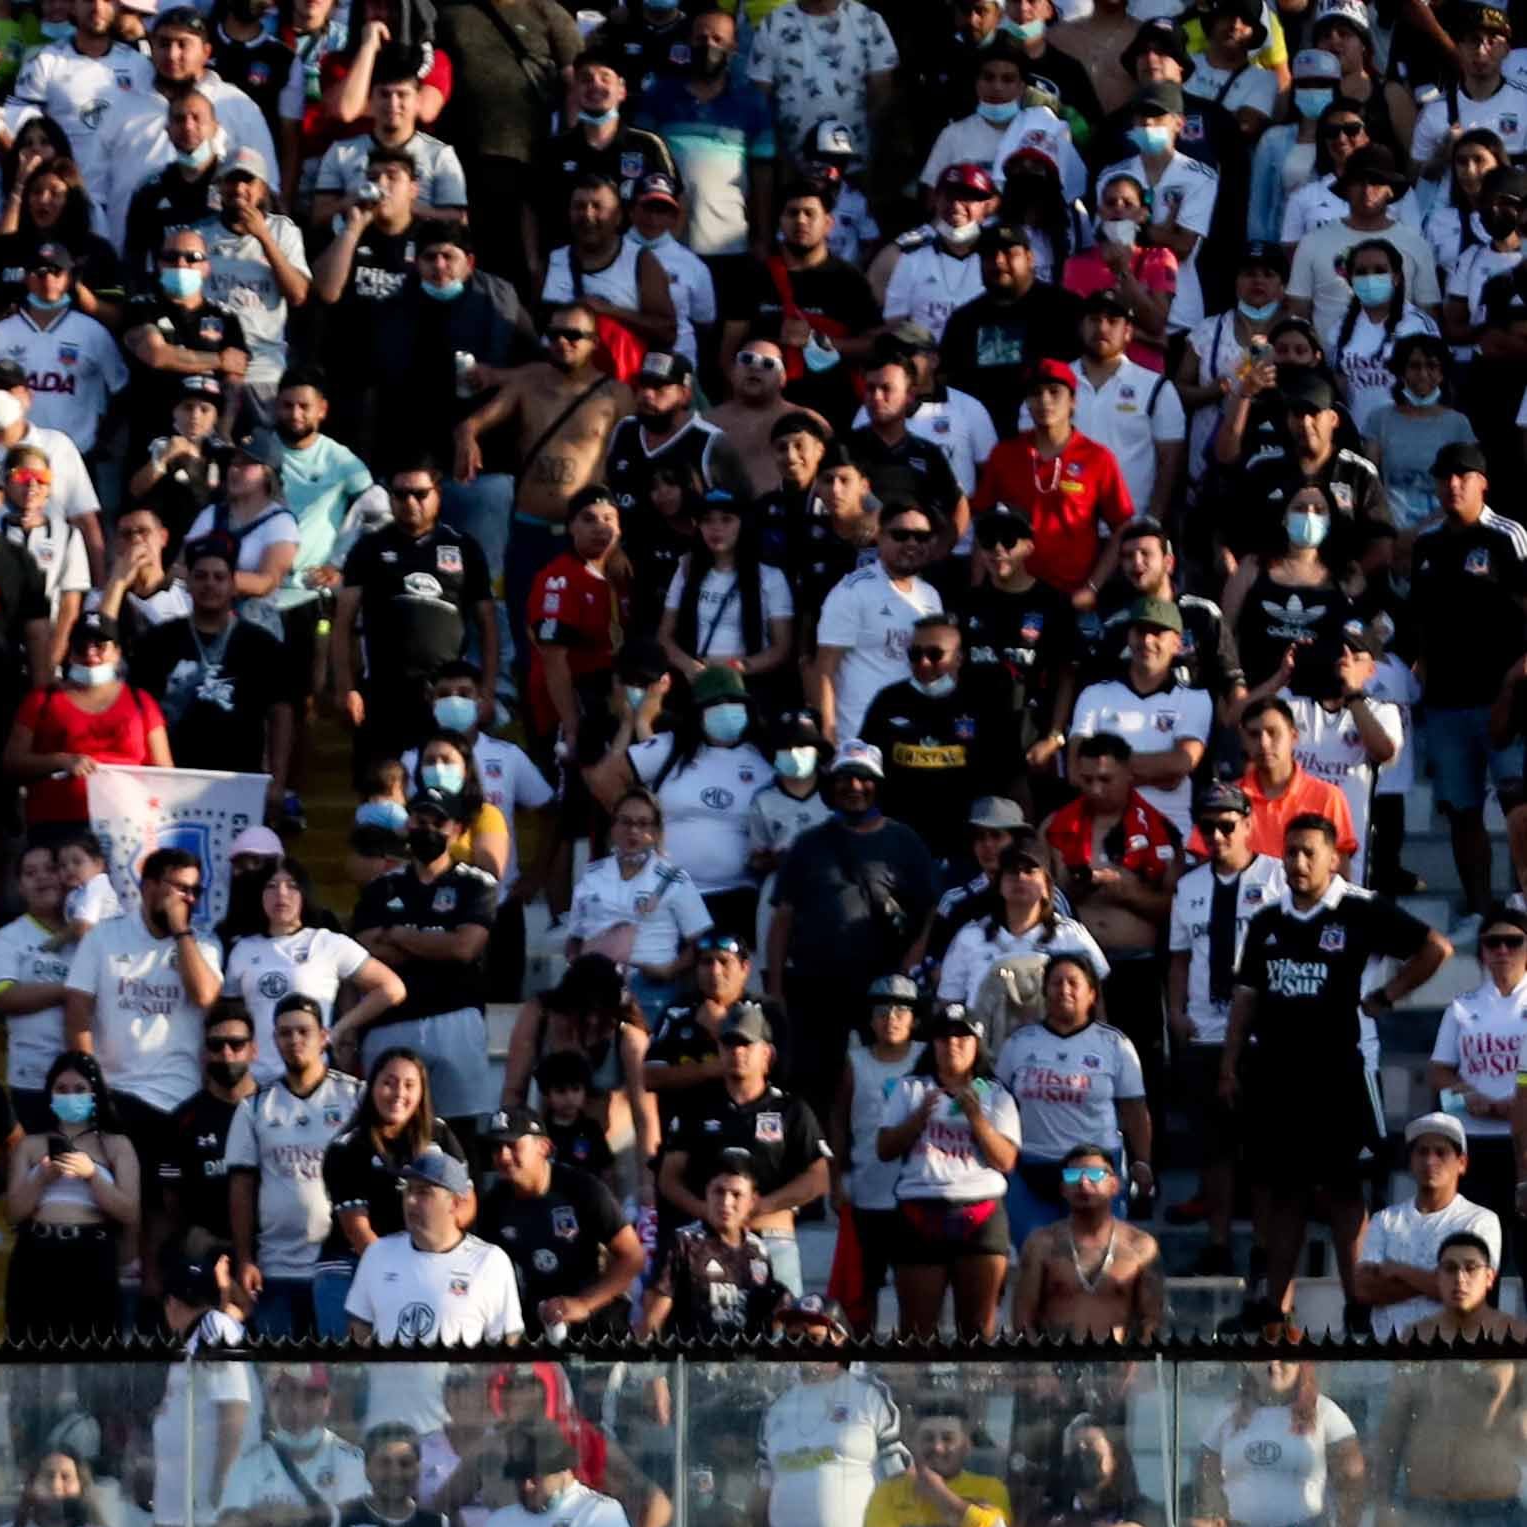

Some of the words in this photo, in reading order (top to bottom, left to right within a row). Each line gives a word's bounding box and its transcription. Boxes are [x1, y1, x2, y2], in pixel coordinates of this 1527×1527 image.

[28, 375, 75, 395] ADA
[700, 786, 734, 809] MG
[1266, 957, 1328, 981] Pilsen
[118, 977, 180, 999] Pilsen
[259, 971, 289, 998] MG
[1282, 977, 1324, 998] Sur
[1461, 1033, 1520, 1056] Pilse
[1022, 1066, 1093, 1089] Pilsen
[1482, 1054, 1522, 1078] Su
[1043, 1085, 1086, 1105] Sur
[399, 1302, 436, 1338] MG
